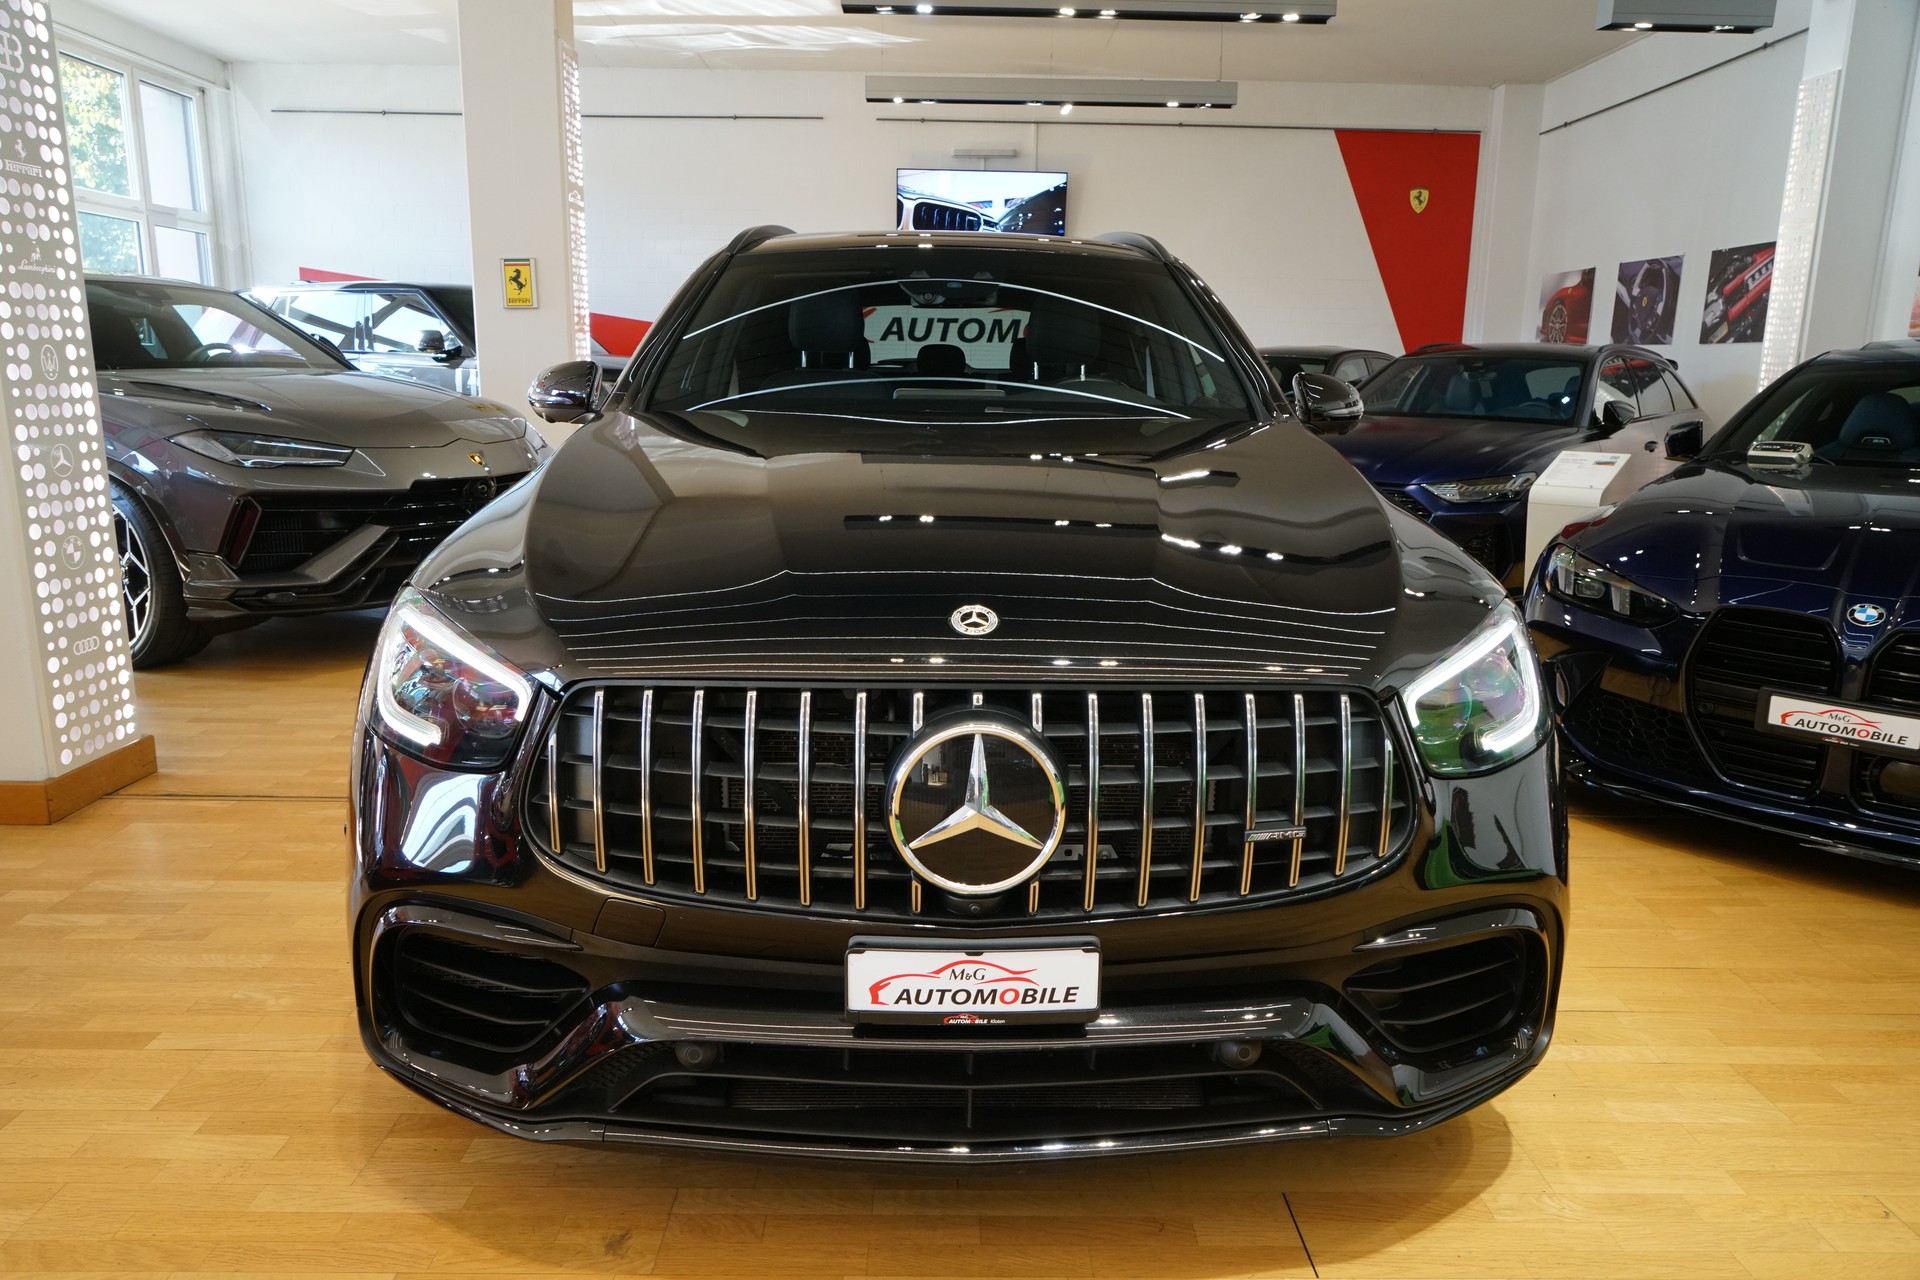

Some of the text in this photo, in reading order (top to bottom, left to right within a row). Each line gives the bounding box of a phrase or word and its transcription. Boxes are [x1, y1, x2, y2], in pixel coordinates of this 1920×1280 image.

[4, 158, 43, 178] Ferrari
[18, 259, 56, 275] Lamborghini
[879, 316, 1027, 344] AUTOM
[1828, 713, 1851, 723] M&G
[1794, 718, 1909, 745] AUTOMOBILE
[949, 968, 987, 981] M&G
[893, 986, 1080, 1006] AUTOMOBILE
